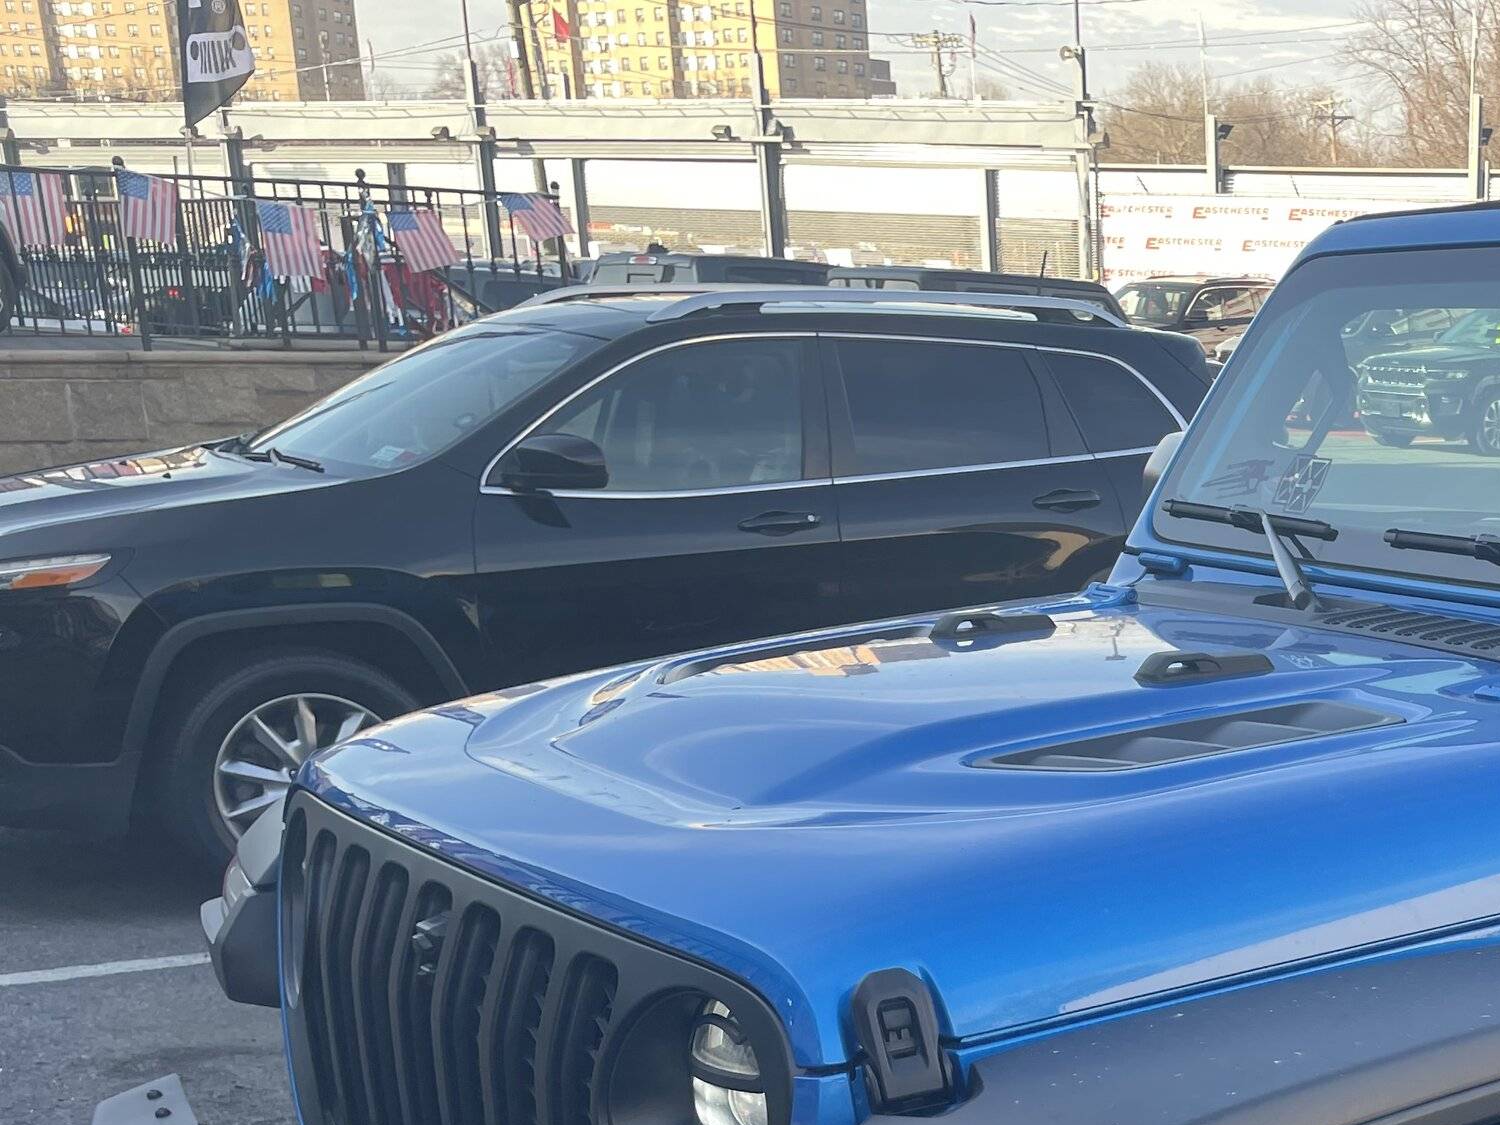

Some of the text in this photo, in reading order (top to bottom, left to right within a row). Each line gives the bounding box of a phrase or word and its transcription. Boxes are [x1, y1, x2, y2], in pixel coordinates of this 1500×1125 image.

[1193, 206, 1269, 219] EASTCHESTER
[1146, 237, 1222, 249] EASTCHESTER
[1242, 240, 1309, 252] EASTCHEST
